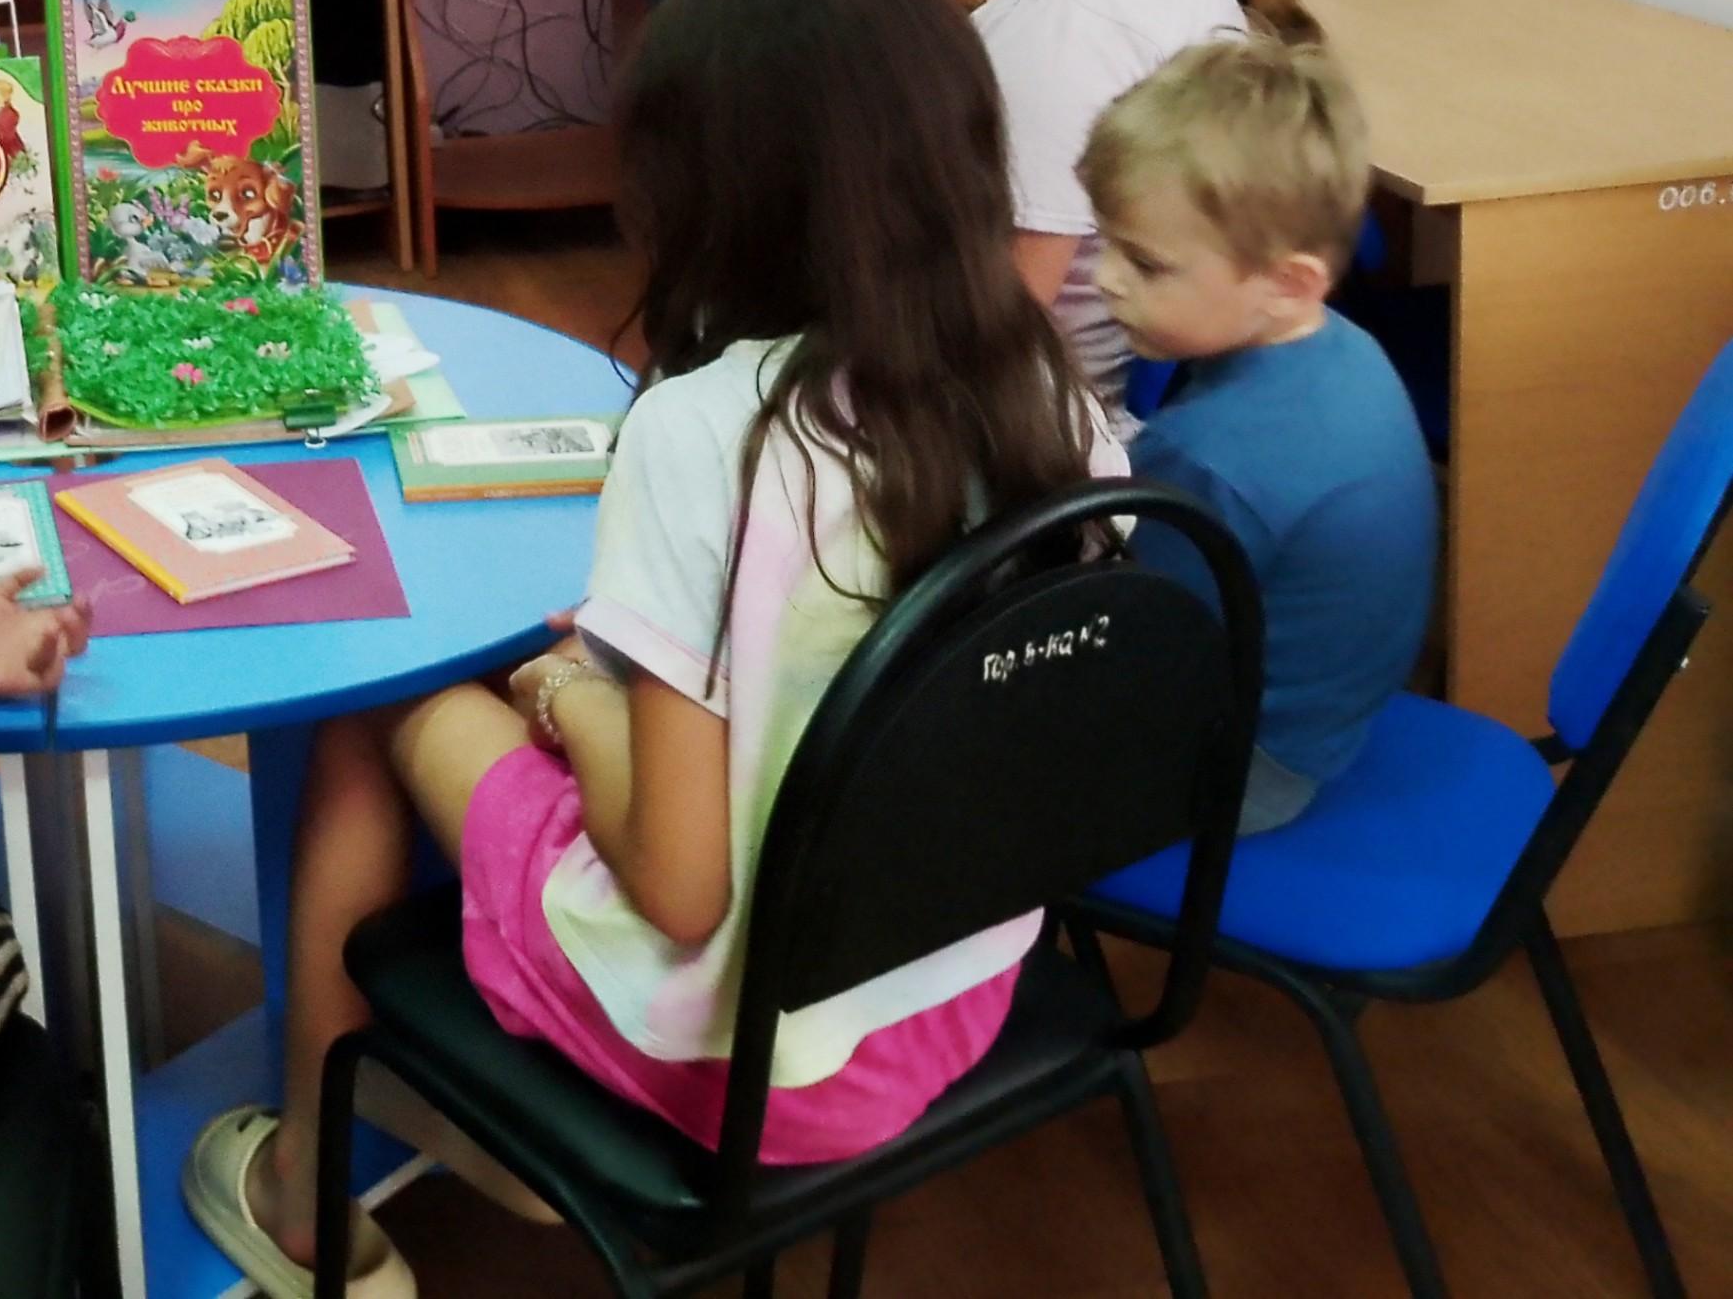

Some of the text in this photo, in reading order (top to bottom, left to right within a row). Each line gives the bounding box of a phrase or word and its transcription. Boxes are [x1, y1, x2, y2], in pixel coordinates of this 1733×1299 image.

[111, 76, 263, 99] Лучшие сказки
[172, 100, 203, 116] про
[141, 119, 238, 136] животных
